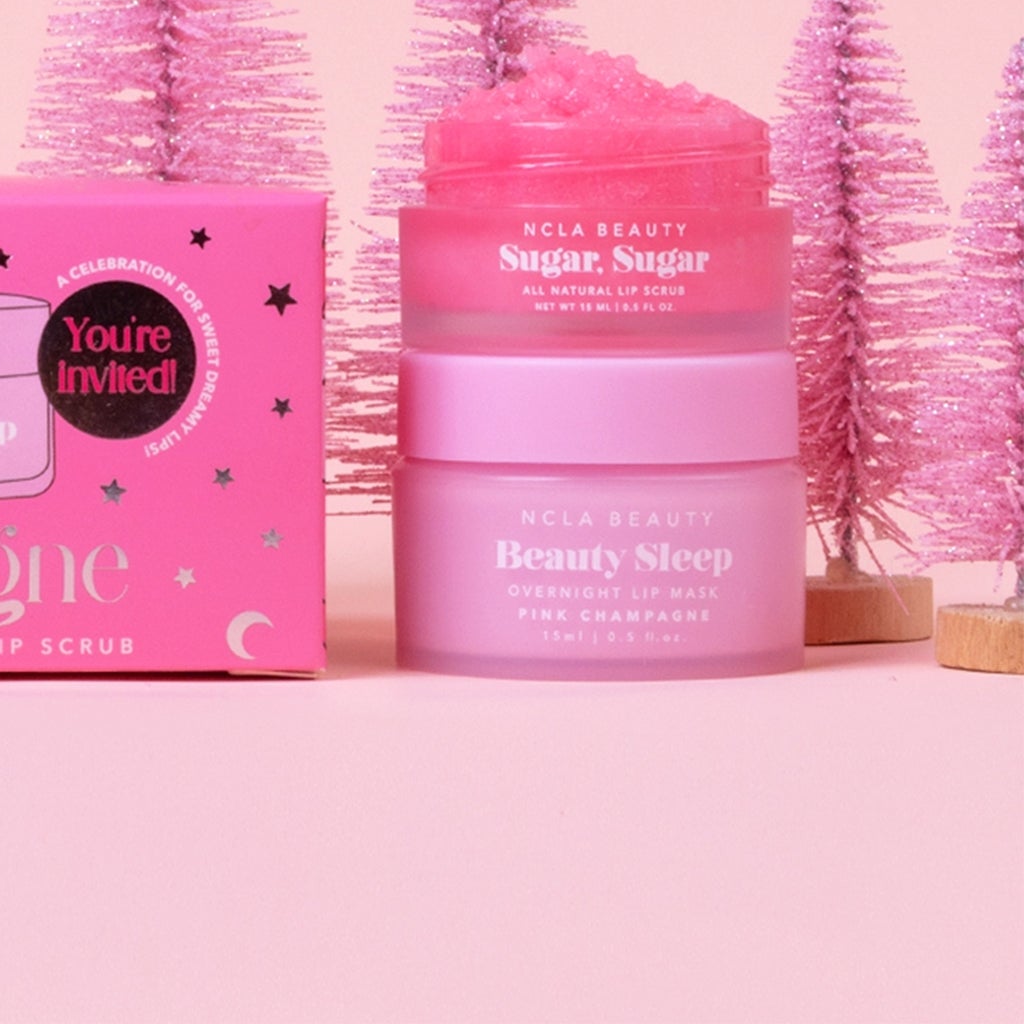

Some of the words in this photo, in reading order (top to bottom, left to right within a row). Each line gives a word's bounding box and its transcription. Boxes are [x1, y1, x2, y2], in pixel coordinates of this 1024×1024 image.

[524, 222, 585, 237] NCLA
[597, 222, 687, 237] BEAUTY
[69, 257, 177, 286] CELEBRATION
[499, 243, 604, 279] Sugar,
[612, 244, 710, 279] Sugar
[56, 275, 69, 288] A
[522, 286, 545, 296] ALL
[550, 286, 612, 296] NATURAL
[618, 286, 638, 296] LIP
[643, 286, 685, 296] SCRUB
[176, 282, 203, 313] FOR
[535, 303, 555, 311] NET
[559, 303, 575, 311] WT
[580, 303, 592, 312] 15
[596, 303, 611, 312] ML
[643, 303, 655, 312] FL
[63, 315, 172, 353] You're
[197, 312, 220, 366] SWEET
[58, 359, 177, 394] invited!
[180, 370, 219, 436] DREAMY
[144, 429, 182, 457] LIPS!
[521, 510, 593, 526] NCLA
[609, 511, 714, 527] BEAUTY
[495, 540, 627, 580] Beauty
[634, 543, 733, 577] Sleep
[507, 584, 622, 599] OVERNIGHT
[632, 587, 659, 599] LIP
[670, 586, 719, 599] MASK
[518, 608, 568, 621] PINK
[580, 610, 710, 622] CHAMPAGNE
[41, 637, 134, 655] SCRUB
